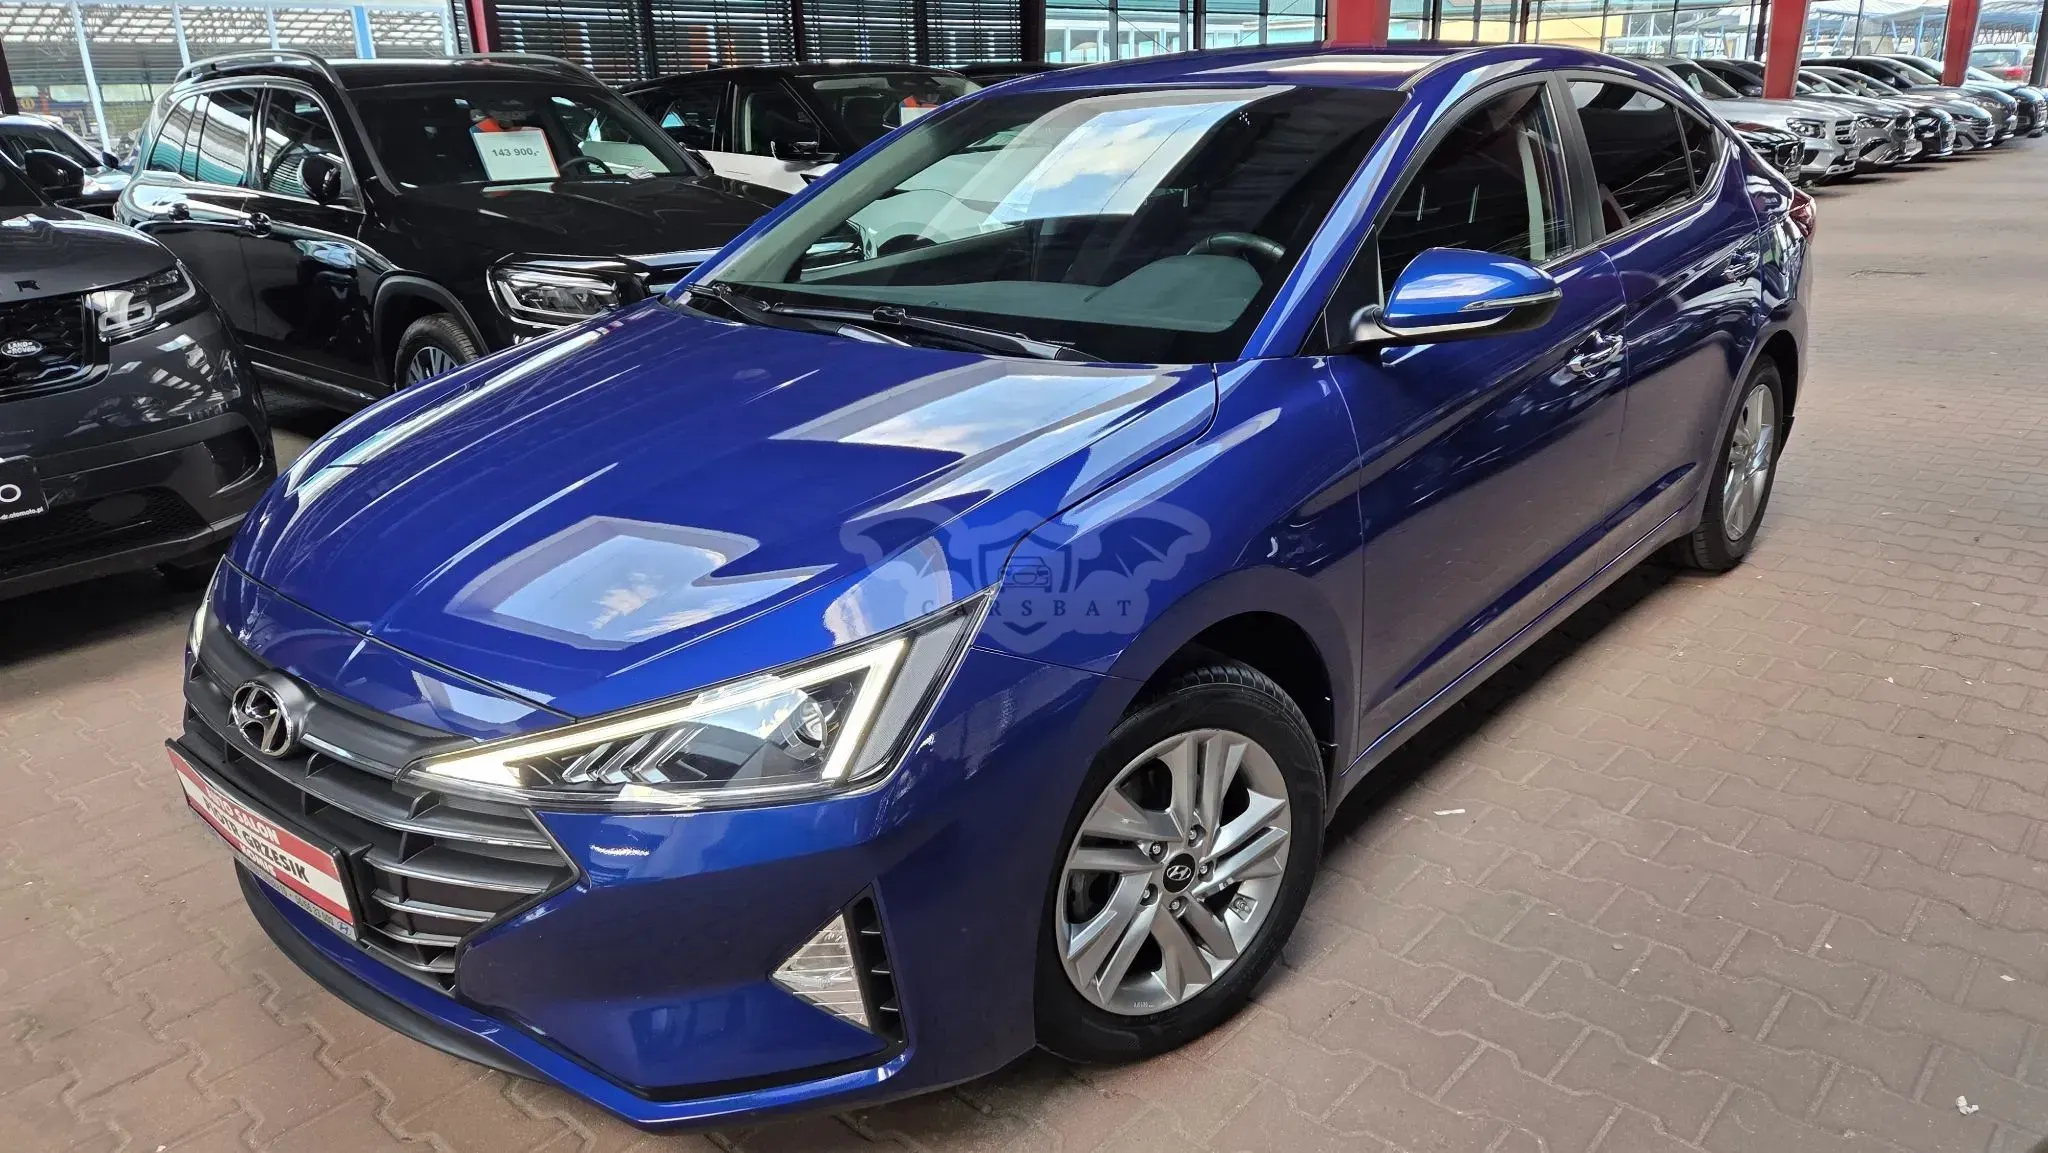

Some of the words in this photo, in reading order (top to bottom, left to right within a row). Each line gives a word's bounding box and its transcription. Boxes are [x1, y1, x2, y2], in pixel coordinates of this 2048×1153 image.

[491, 148, 512, 157] 143
[202, 795, 242, 840] PIOTR
[242, 830, 311, 885] GRZESIK
[234, 808, 281, 846] SALON
[239, 842, 277, 878] KOMIS
